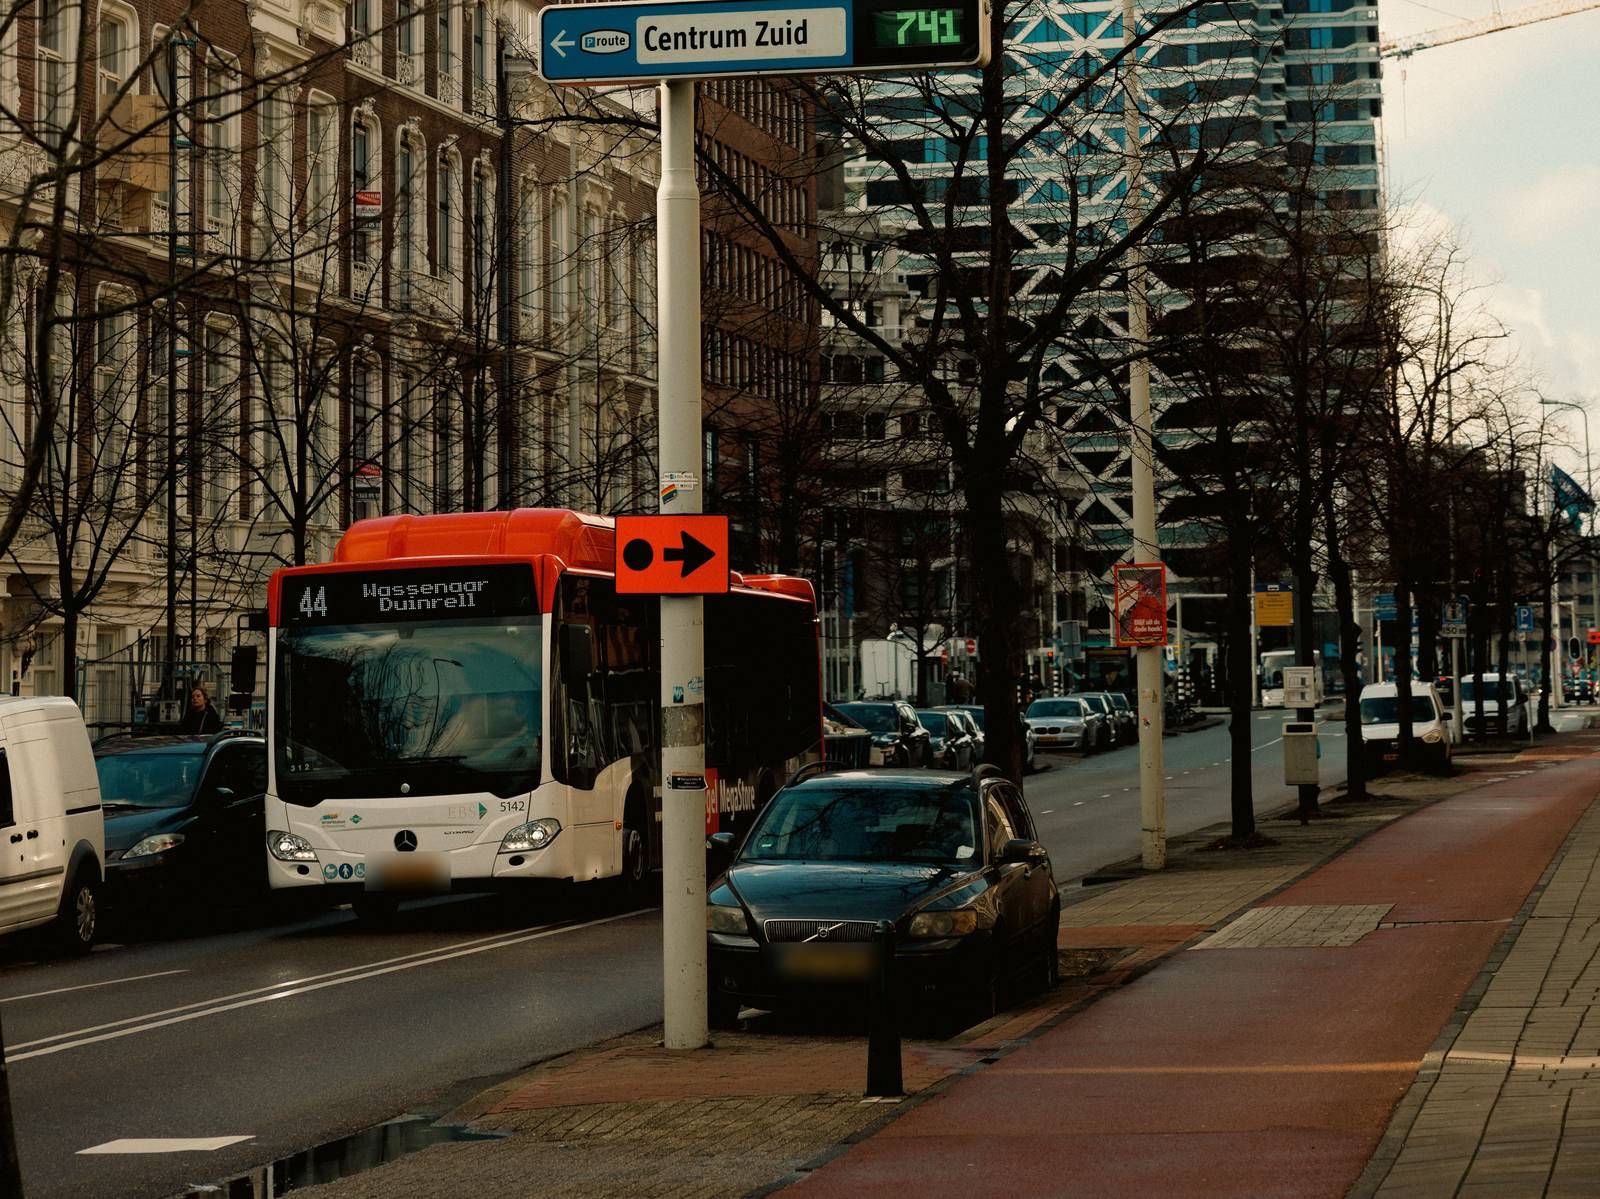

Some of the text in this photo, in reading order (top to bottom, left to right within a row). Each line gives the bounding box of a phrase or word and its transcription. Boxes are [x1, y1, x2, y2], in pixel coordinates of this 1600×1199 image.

[644, 19, 808, 52] Centrum Zuid
[896, 10, 961, 45] 741
[596, 35, 626, 47] route
[362, 580, 489, 598] Wassenaar
[300, 586, 328, 618] 44
[379, 593, 477, 612] Duinrell
[1520, 608, 1529, 622] P
[500, 801, 525, 812] 5142
[705, 778, 756, 825] gel MegaStore
